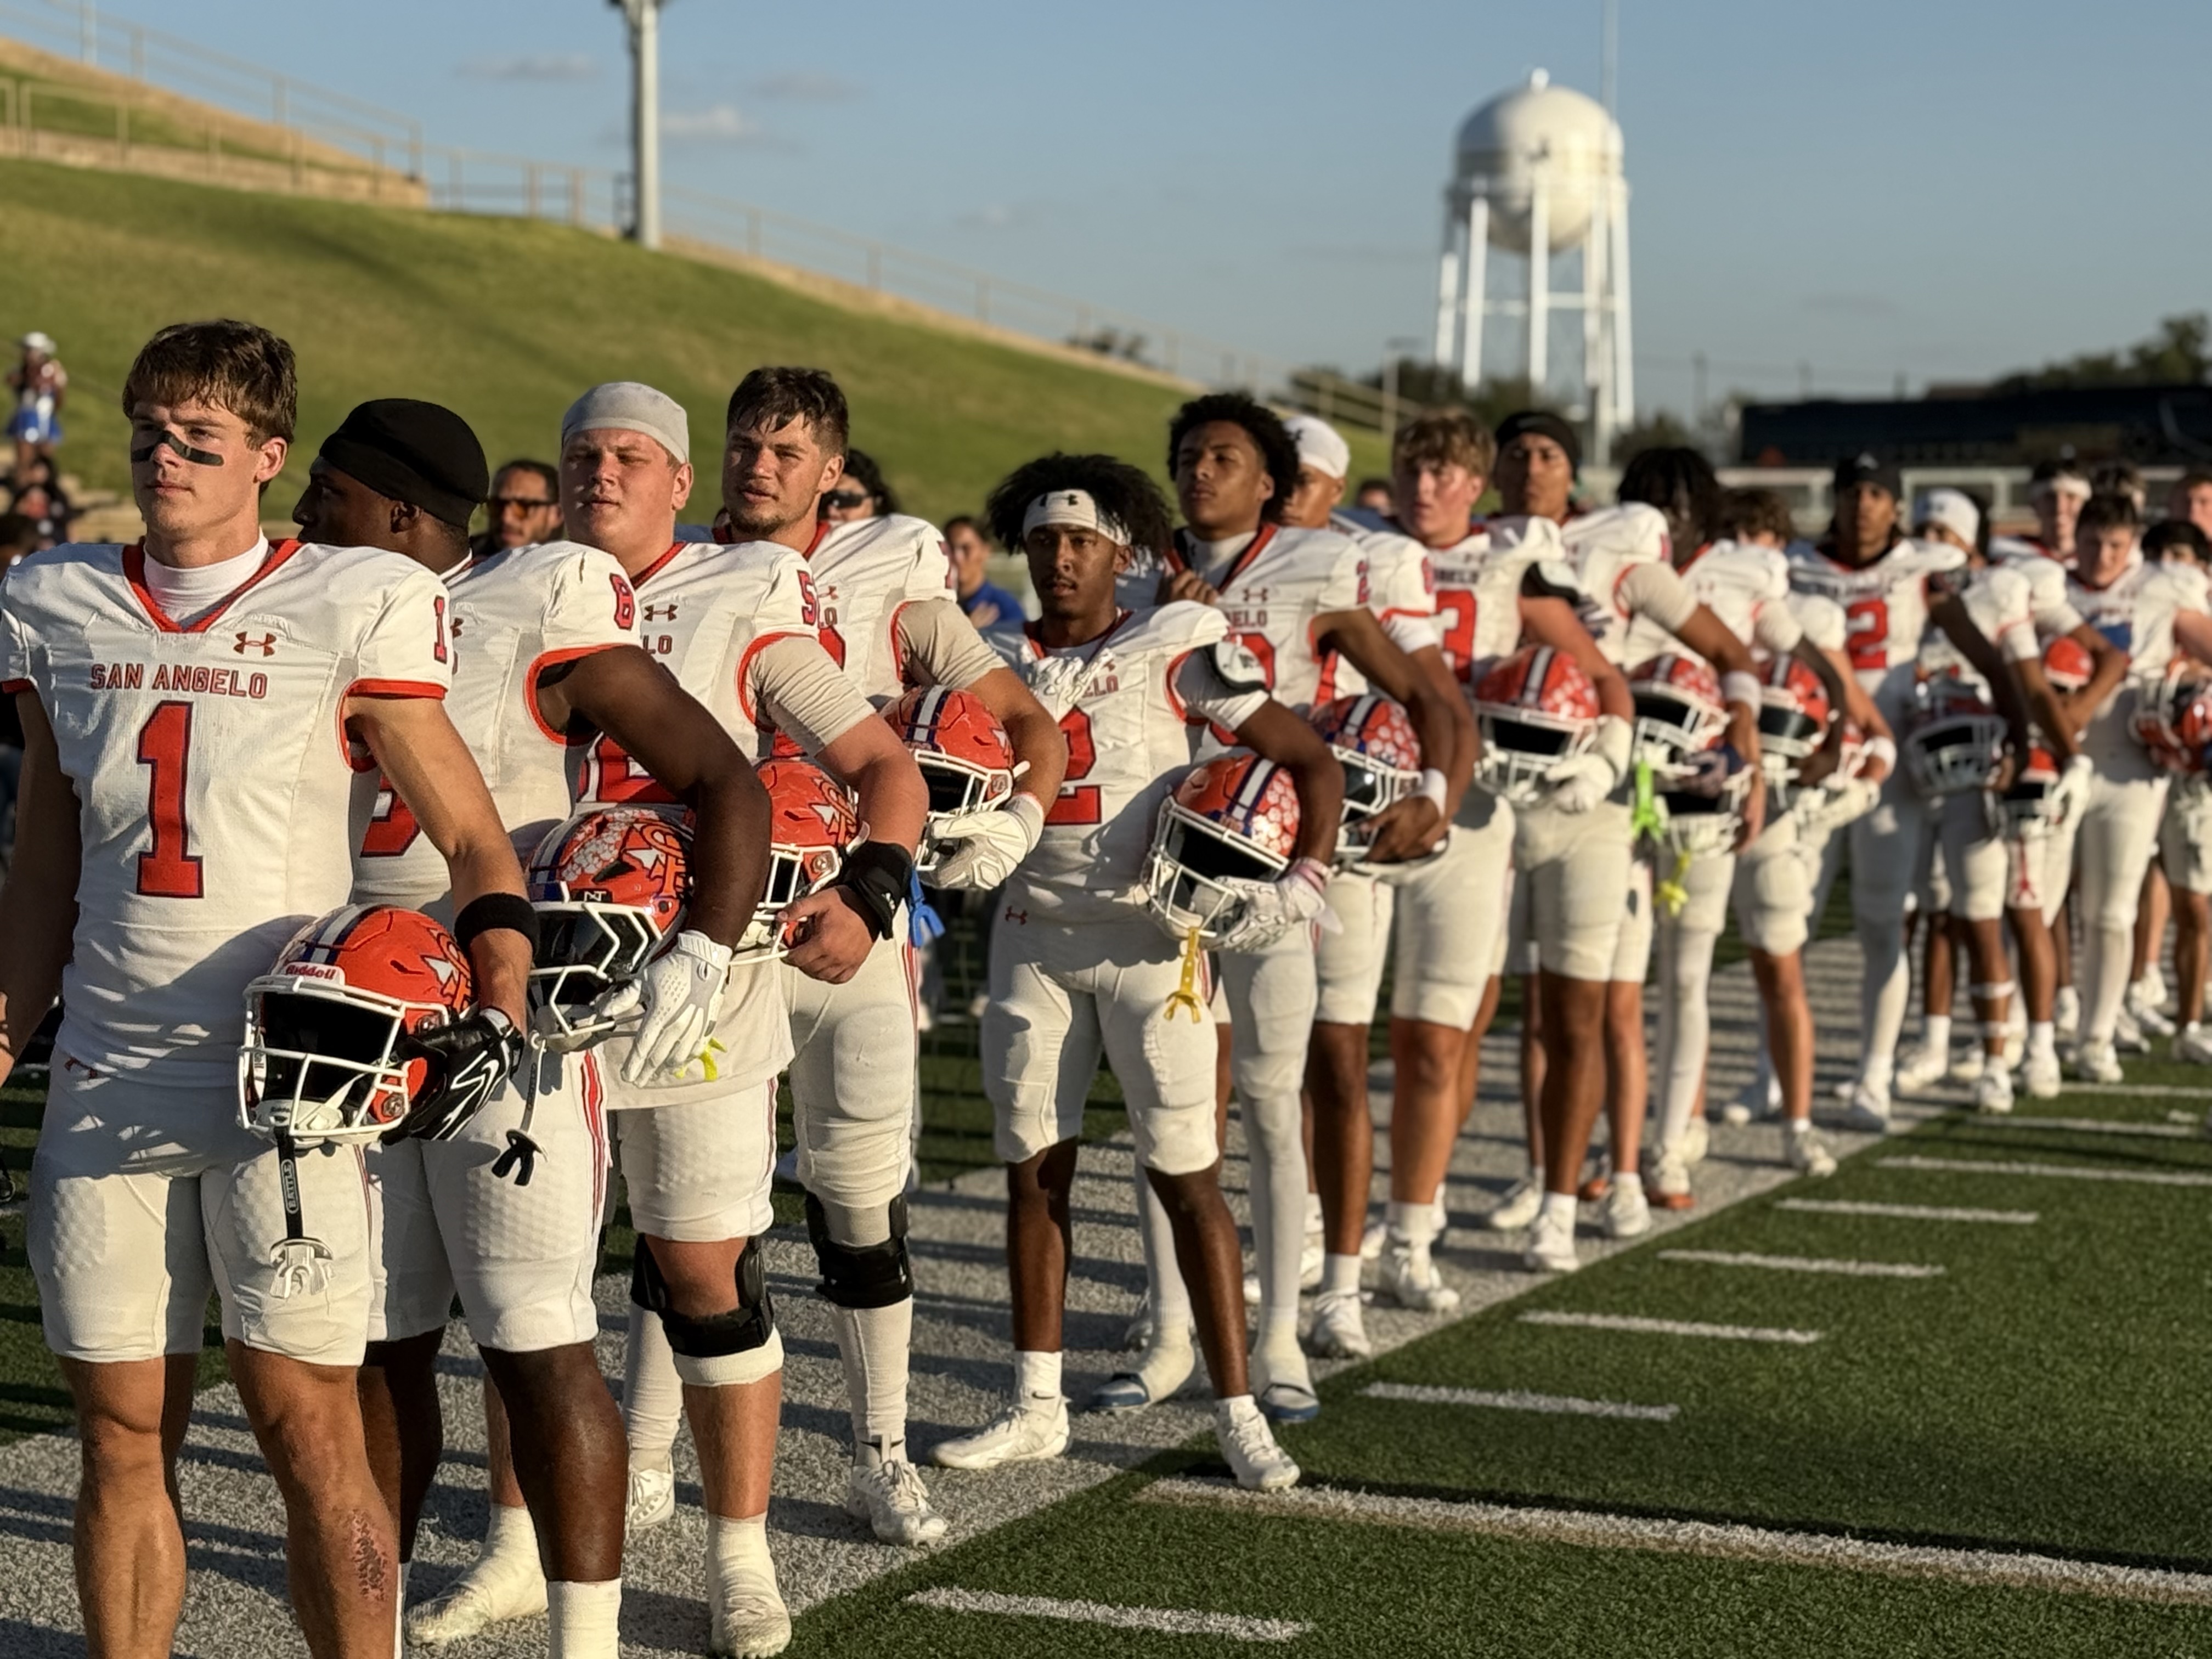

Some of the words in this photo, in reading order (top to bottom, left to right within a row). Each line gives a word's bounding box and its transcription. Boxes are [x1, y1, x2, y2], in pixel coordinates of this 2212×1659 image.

[433, 595, 447, 664] 1
[90, 663, 144, 690] SAN
[151, 664, 268, 699] ANGELO
[137, 699, 204, 899] 1
[283, 1163, 297, 1209] BATTLE
